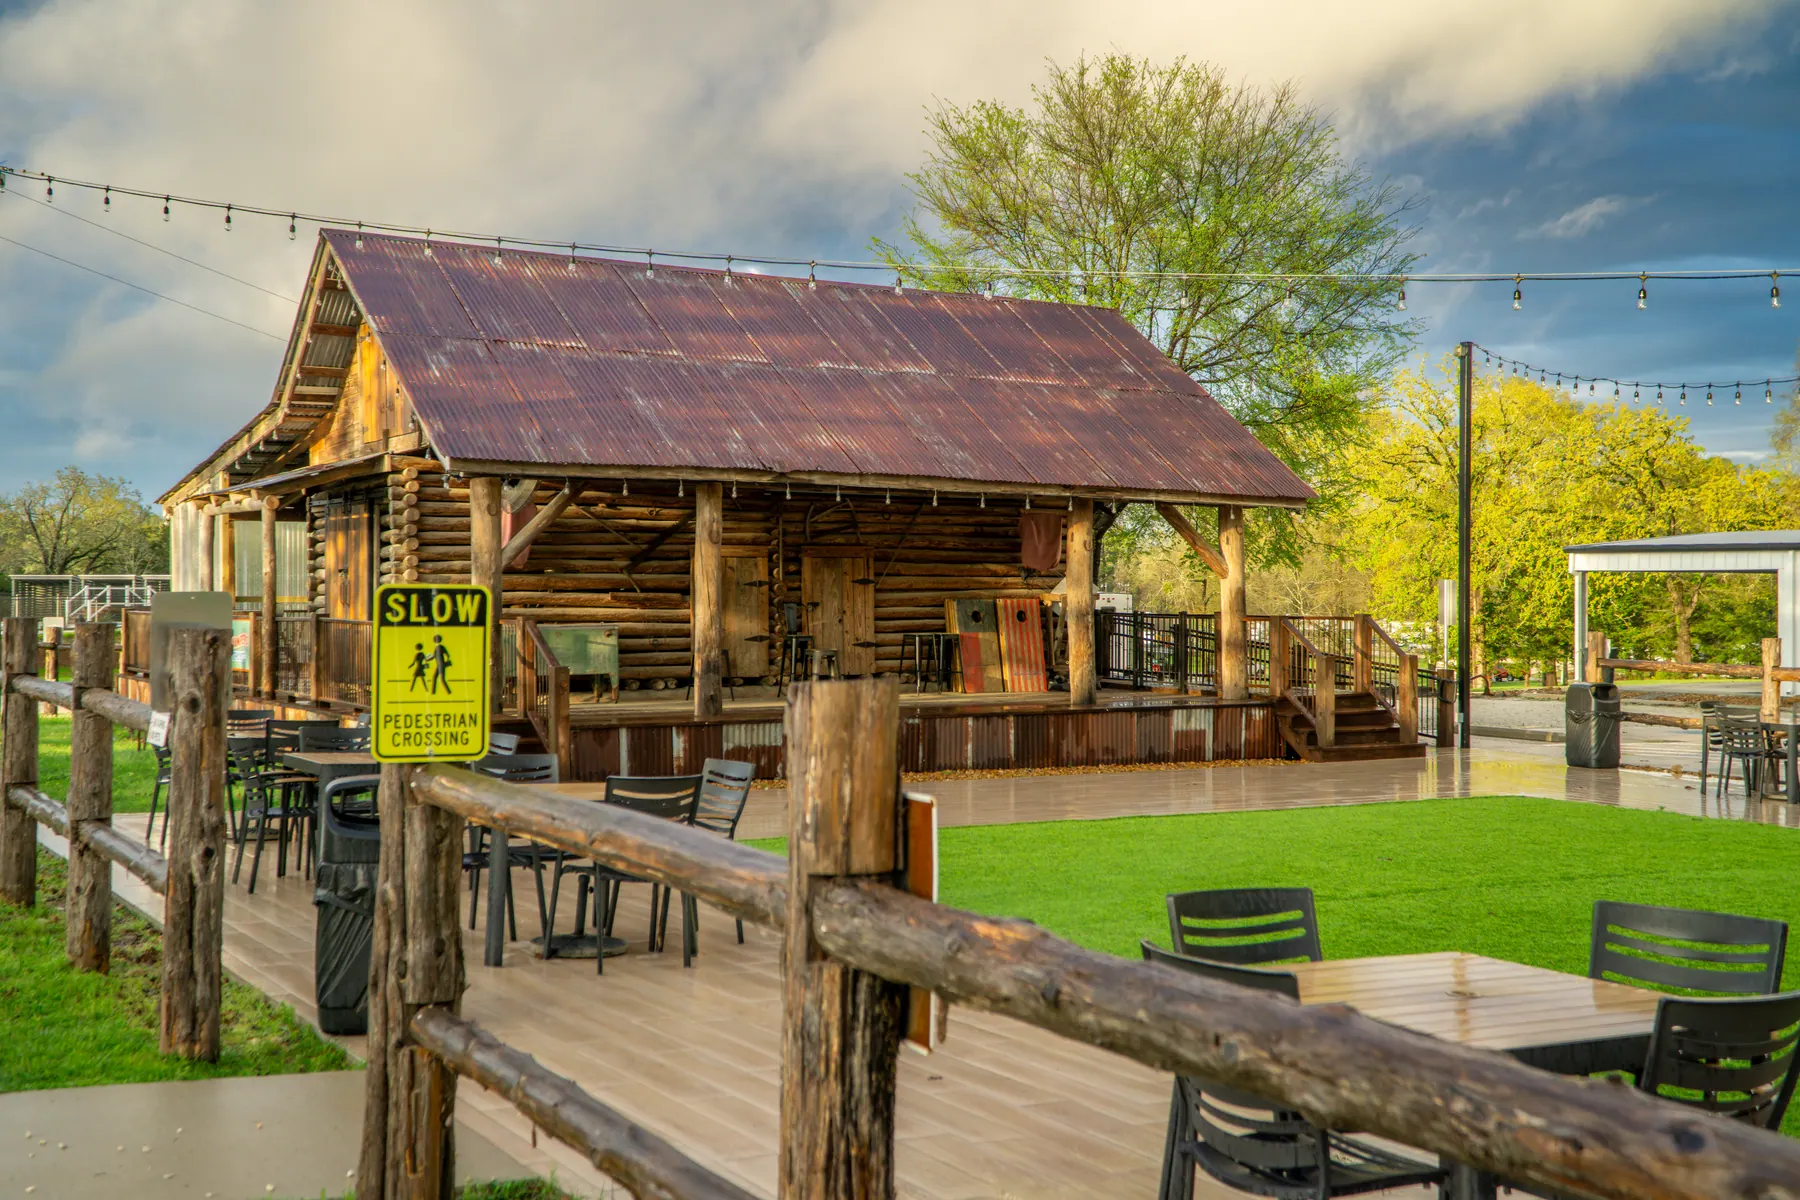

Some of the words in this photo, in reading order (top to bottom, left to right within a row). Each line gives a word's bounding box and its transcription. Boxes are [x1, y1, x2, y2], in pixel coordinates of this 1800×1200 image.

[385, 593, 482, 623] SLOW
[383, 713, 478, 729] PEDESTRIAN
[391, 730, 470, 747] CROSSING
